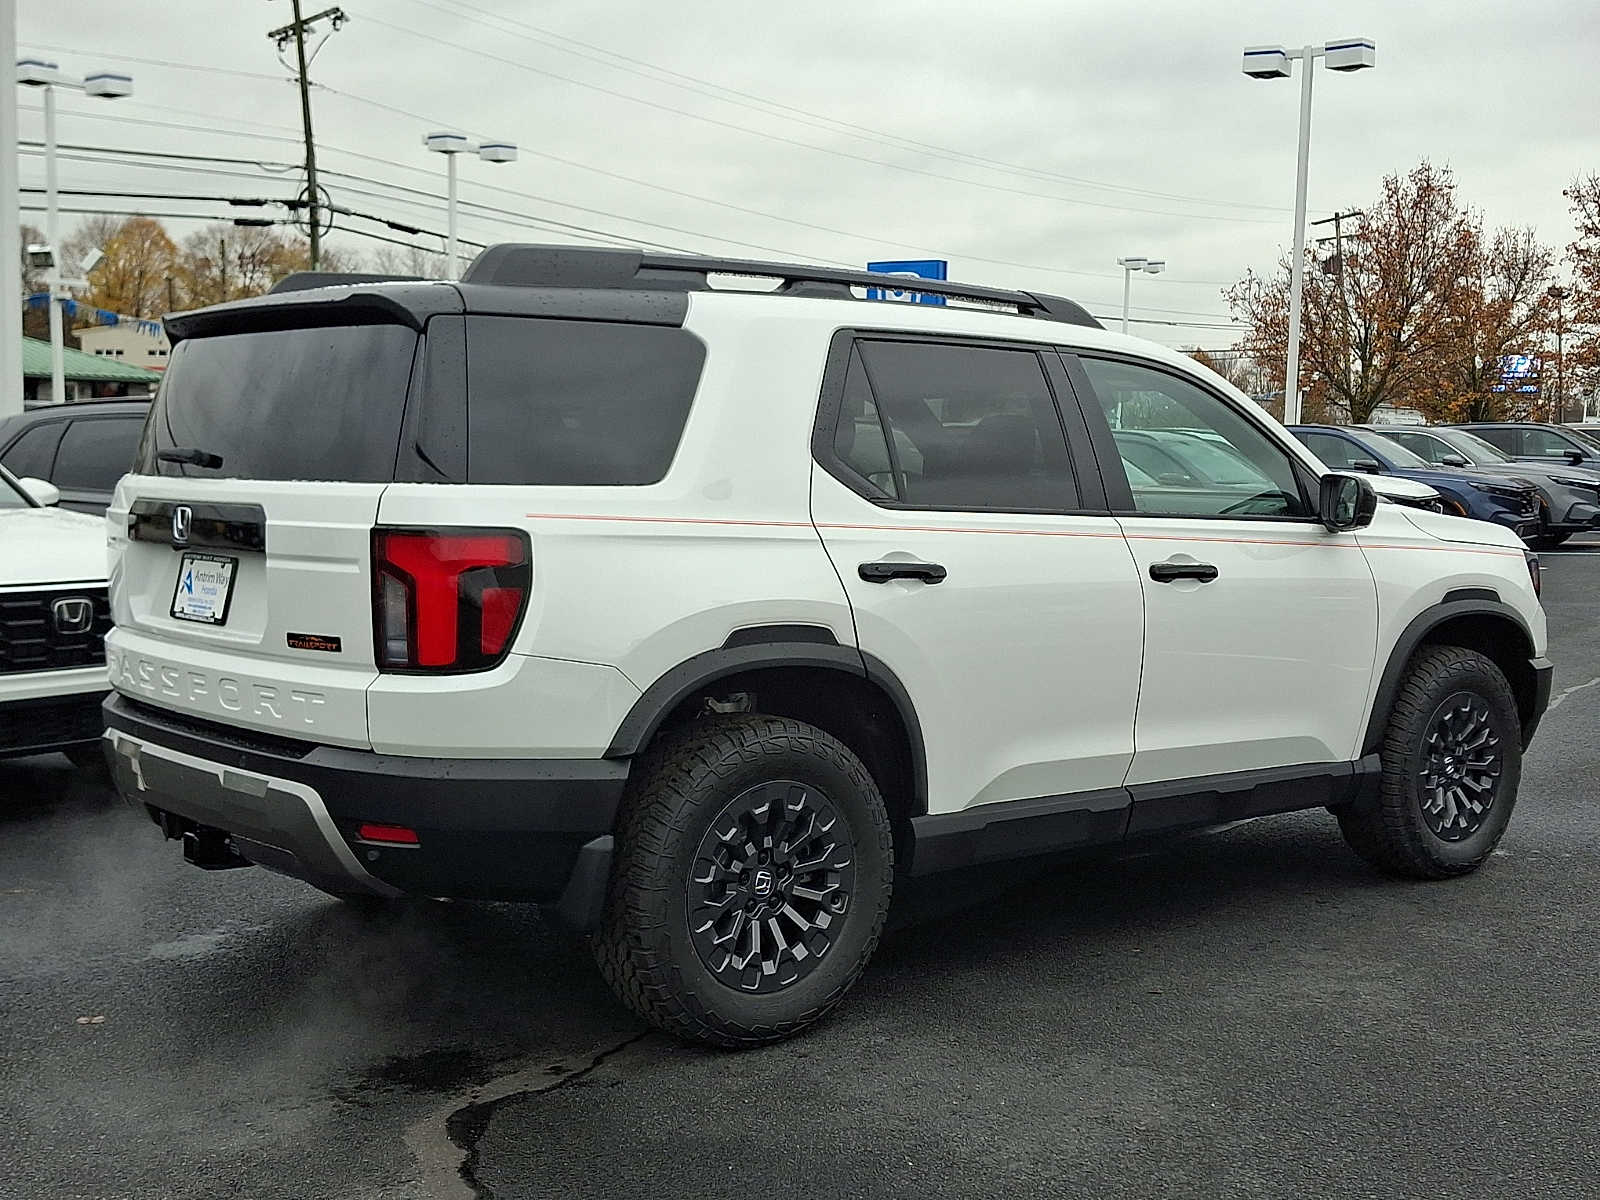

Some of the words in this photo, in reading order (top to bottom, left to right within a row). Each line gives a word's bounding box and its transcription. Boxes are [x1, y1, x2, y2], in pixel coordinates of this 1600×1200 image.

[195, 570, 215, 583] Antrim
[215, 571, 230, 588] Way
[287, 639, 338, 650] TRAILSPORT
